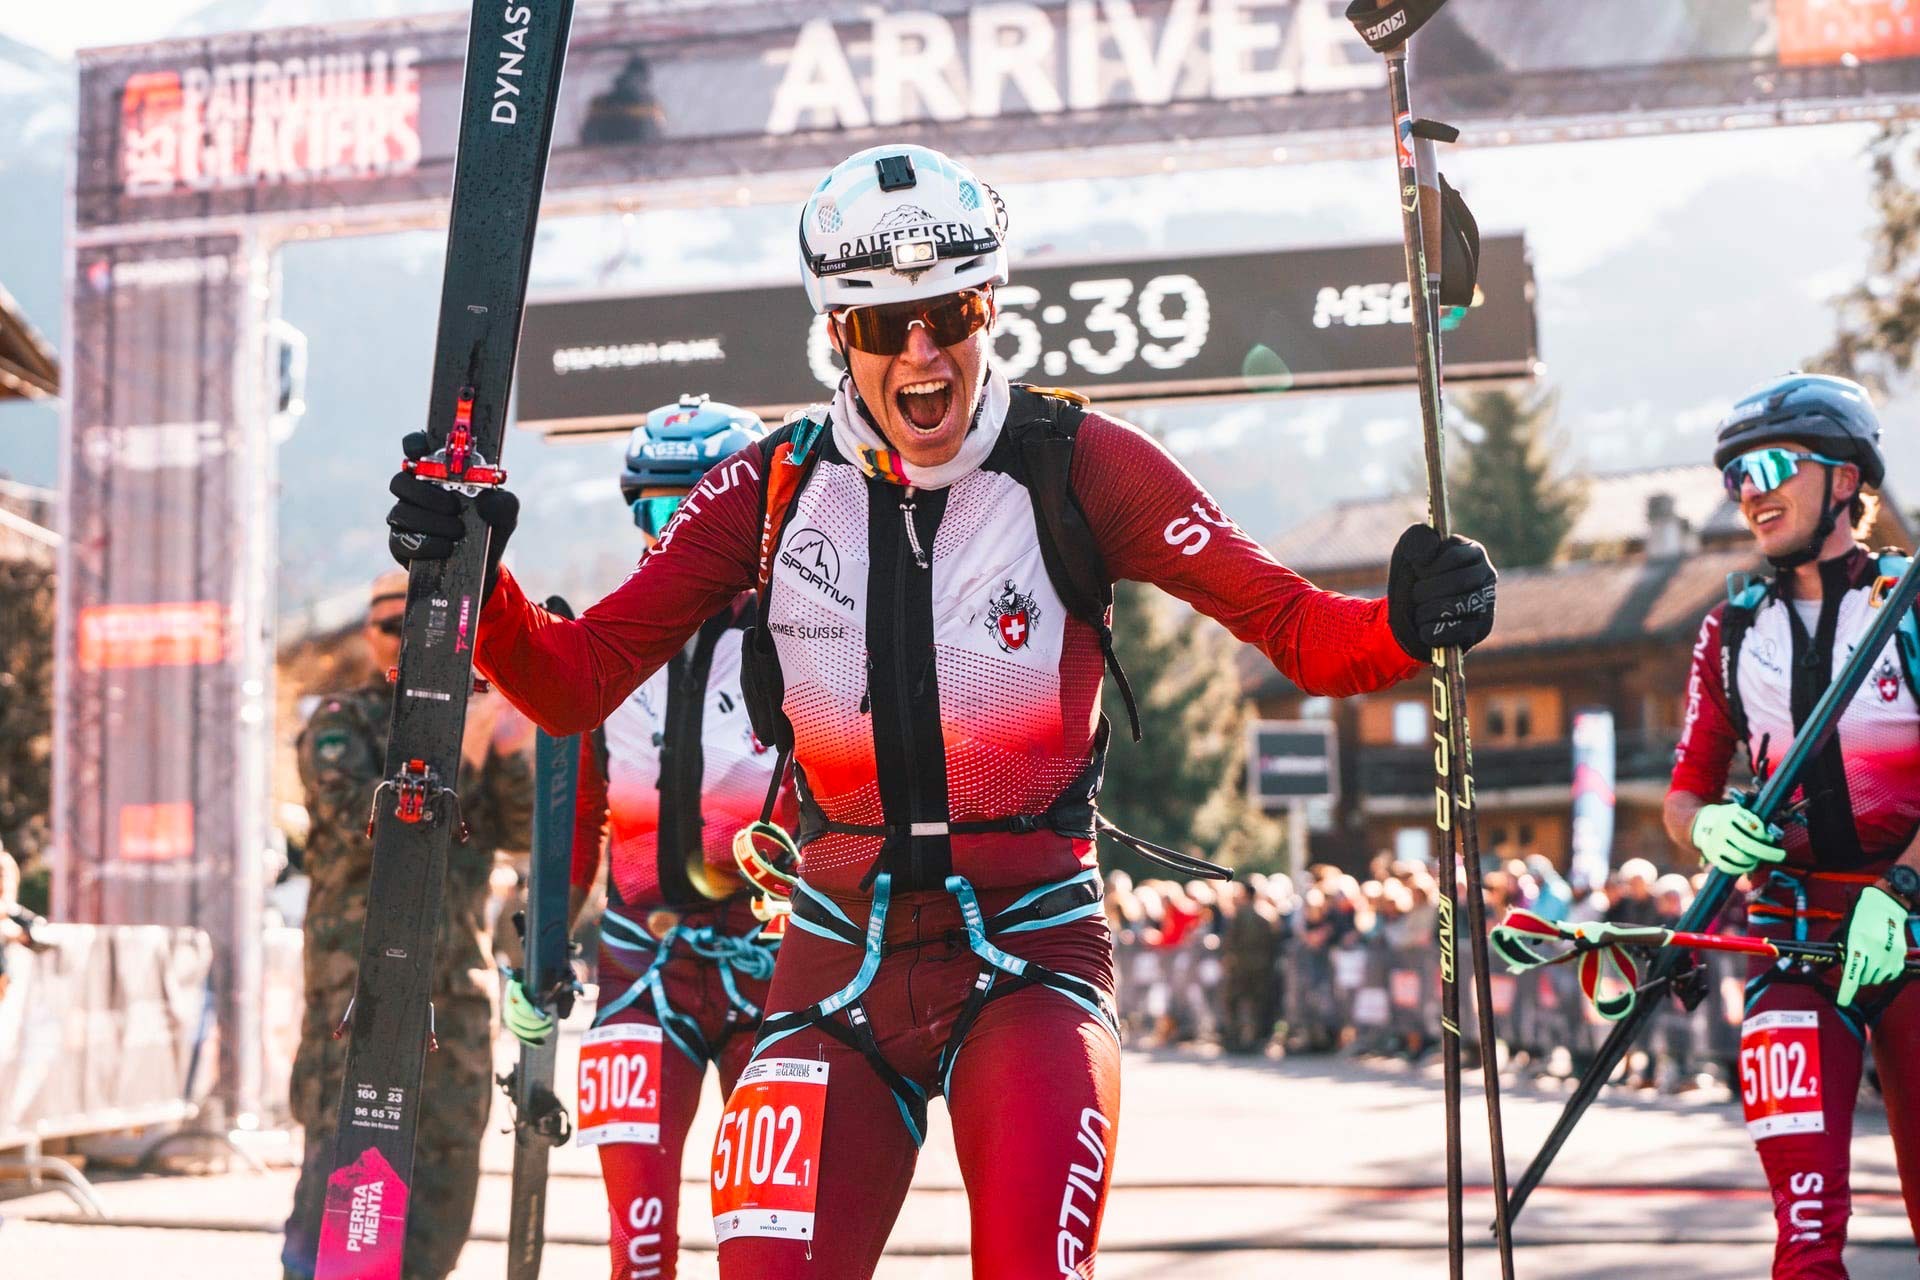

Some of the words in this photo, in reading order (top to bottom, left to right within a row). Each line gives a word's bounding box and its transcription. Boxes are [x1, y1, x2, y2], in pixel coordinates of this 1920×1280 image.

[490, 0, 532, 124] DYNAS
[431, 598, 448, 607] 160
[798, 626, 845, 639] SUISSE
[357, 1089, 377, 1100] 160
[387, 1092, 403, 1103] 23
[354, 1106, 369, 1117] 96
[371, 1108, 385, 1119] 65
[387, 1110, 401, 1120] 79
[346, 1184, 369, 1252] PIERRA
[362, 1181, 384, 1245] MENTA
